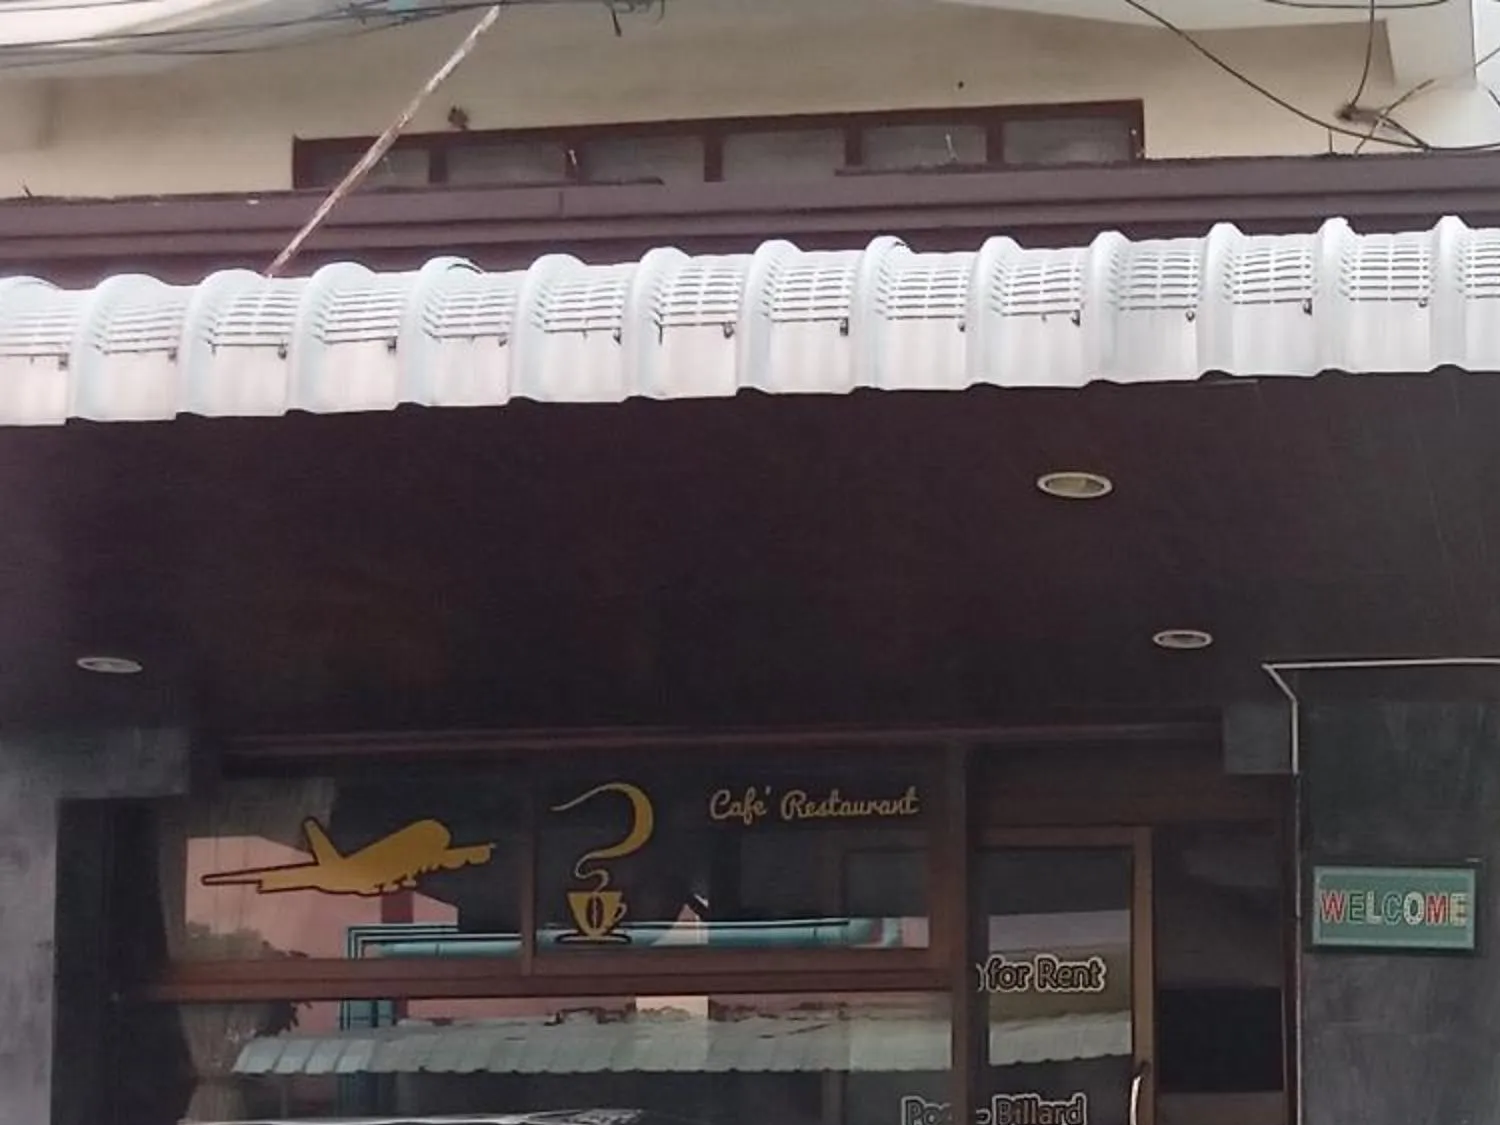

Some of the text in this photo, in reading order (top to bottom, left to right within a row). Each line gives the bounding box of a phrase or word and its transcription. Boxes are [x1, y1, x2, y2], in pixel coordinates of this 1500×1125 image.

[780, 786, 920, 820] Restaurant
[1320, 889, 1469, 926] WELCOME
[986, 954, 1107, 992] for Rent
